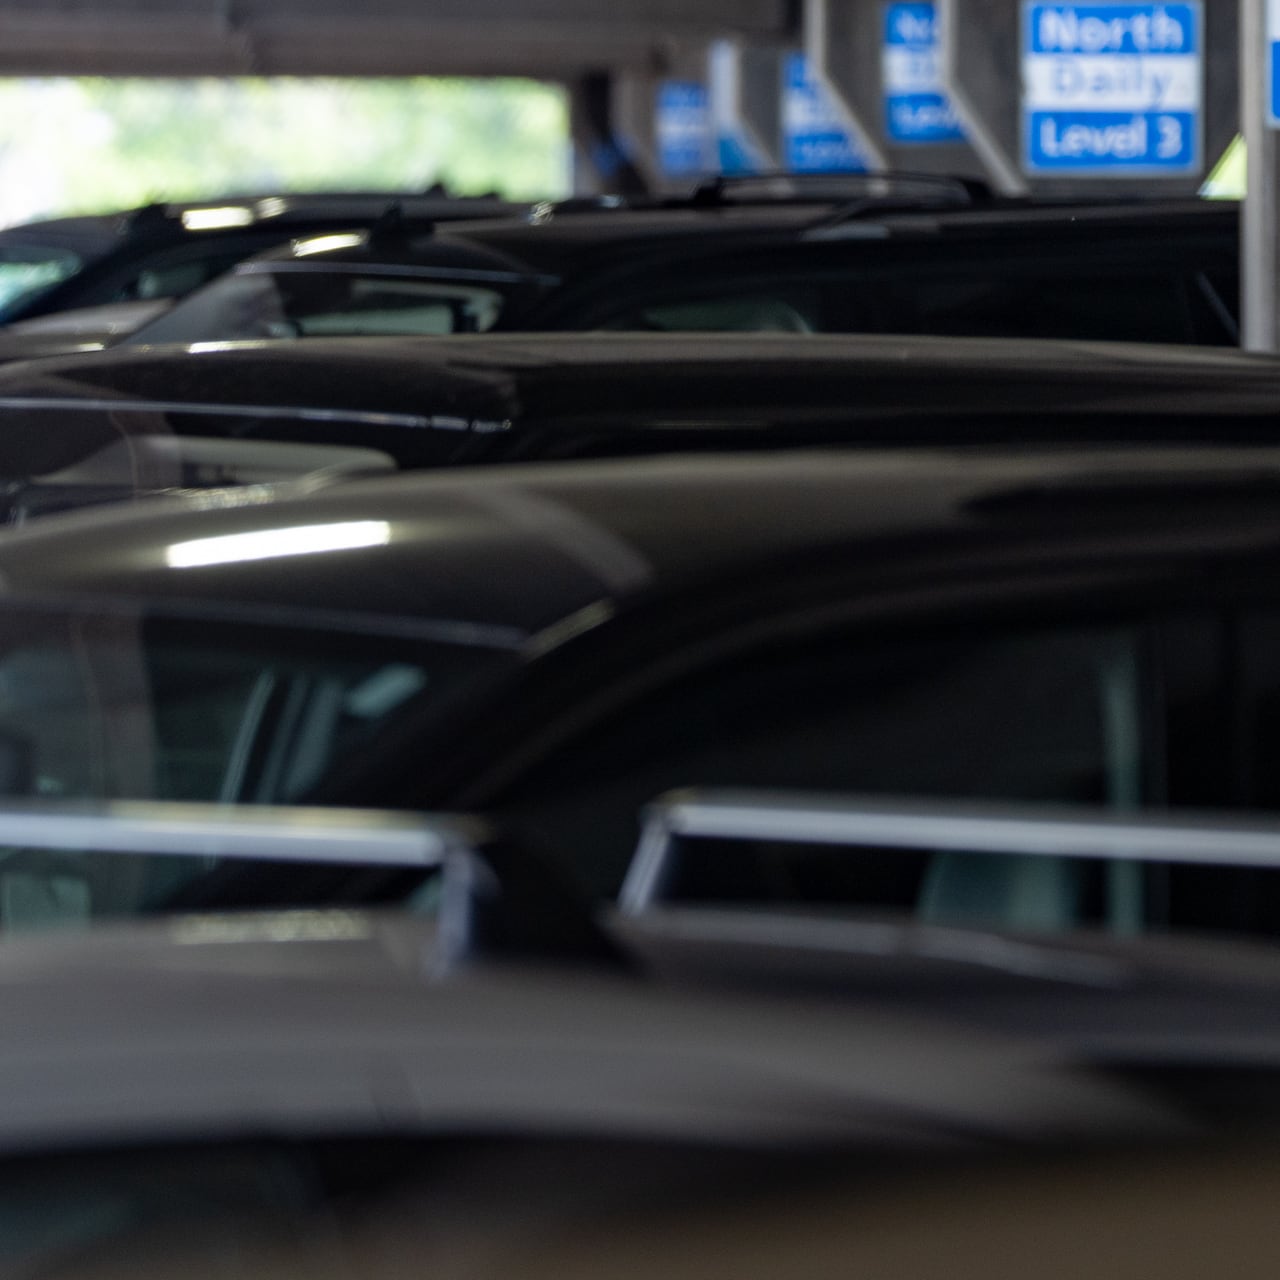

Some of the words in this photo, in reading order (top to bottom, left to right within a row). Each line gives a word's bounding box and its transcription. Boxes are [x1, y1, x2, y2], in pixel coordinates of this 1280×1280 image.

[1039, 7, 1184, 52] North
[1051, 56, 1173, 110] Daily
[1040, 115, 1148, 158] Level
[1156, 115, 1183, 158] 3
